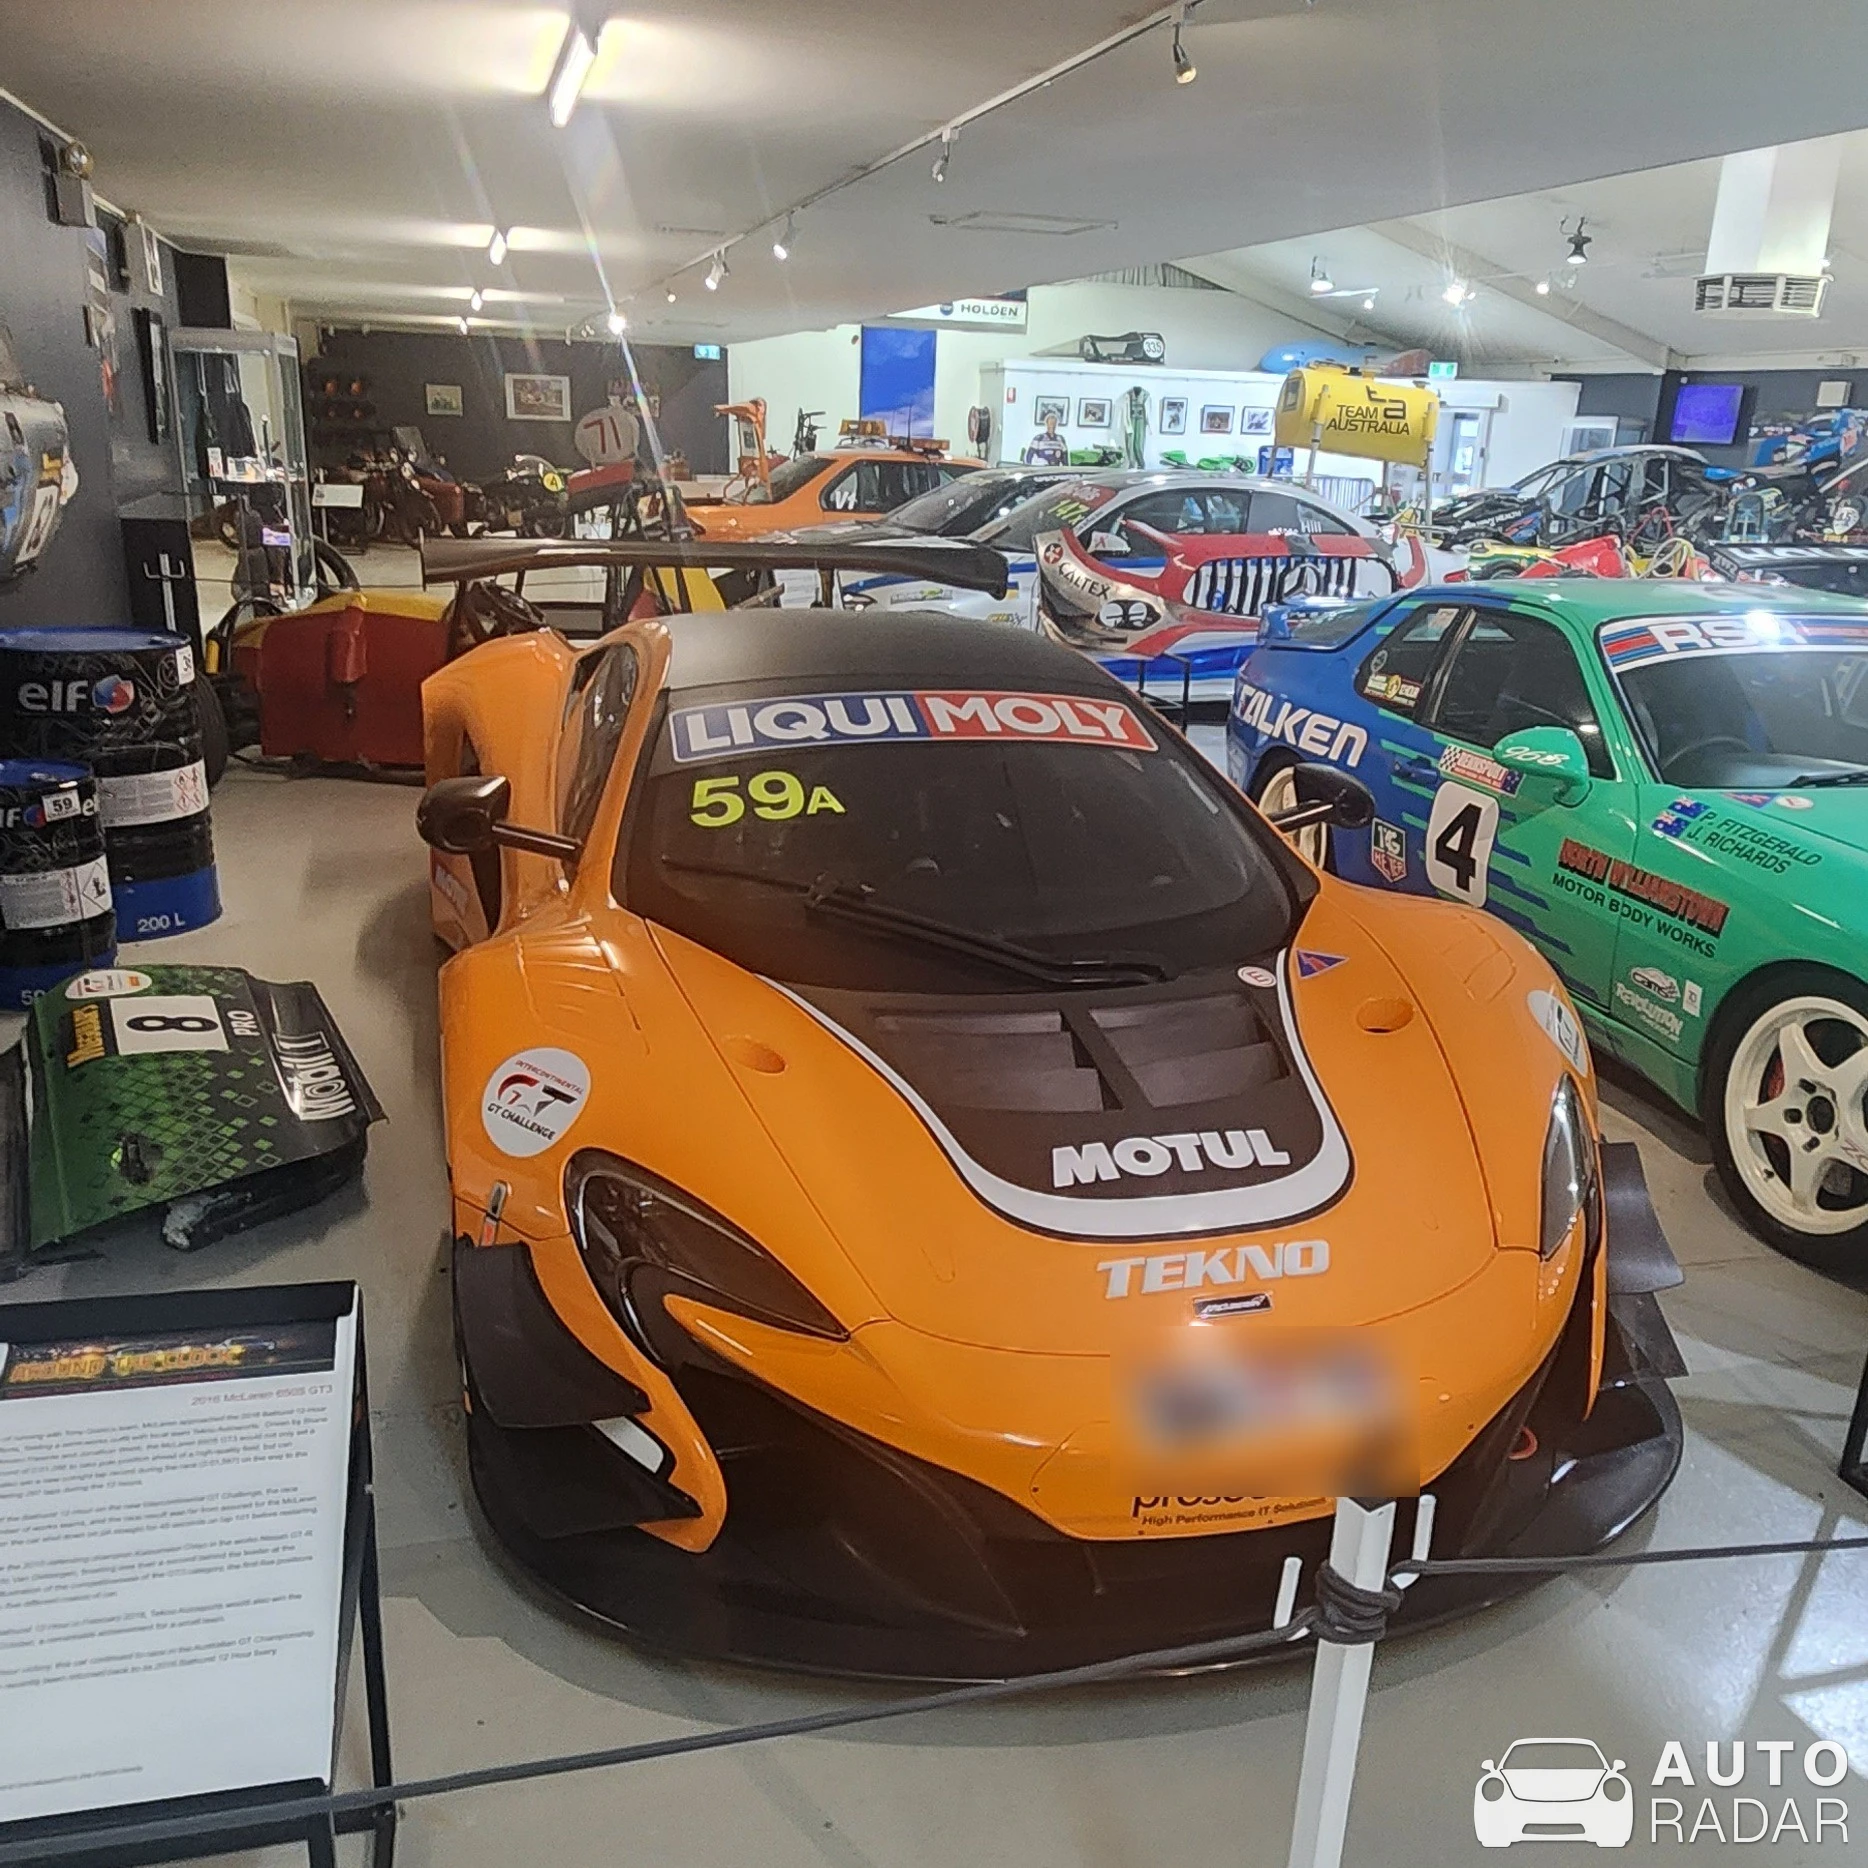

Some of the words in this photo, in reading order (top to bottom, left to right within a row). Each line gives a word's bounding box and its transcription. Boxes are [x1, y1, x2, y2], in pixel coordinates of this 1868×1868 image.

[960, 303, 1018, 317] HOLDEN
[1326, 418, 1410, 436] AUSTRALIA
[1337, 404, 1379, 419] TEAM
[1417, 472, 1442, 482] EIT
[1058, 562, 1112, 600] CALTEX
[18, 680, 89, 711] elf
[685, 696, 916, 753] LIQUI
[925, 695, 1131, 741] MOLY
[1237, 684, 1368, 768] FALKEN
[1502, 746, 1570, 769] 968
[52, 797, 73, 814] 59
[689, 770, 847, 828] 59A
[1435, 803, 1483, 893] 4
[1699, 811, 1718, 826] P.
[1717, 818, 1822, 866] FITZGERALD
[1699, 832, 1792, 874] RICHARDS
[137, 914, 171, 933] 200
[174, 912, 186, 927] L
[1552, 873, 1606, 907] MOTOR
[1609, 898, 1653, 928] BODY
[1656, 919, 1716, 959] WORKS
[227, 1010, 260, 1037] PRO
[515, 1060, 585, 1095] INTERCONTINENTAL
[487, 1102, 503, 1115] GT
[501, 1109, 556, 1141] CHALLENGE
[1052, 1129, 1291, 1189] MOTUL
[1096, 1239, 1331, 1300] TEKNO
[308, 1384, 333, 1395] GT3
[1141, 1515, 1173, 1526] High
[1258, 1505, 1271, 1516] IT
